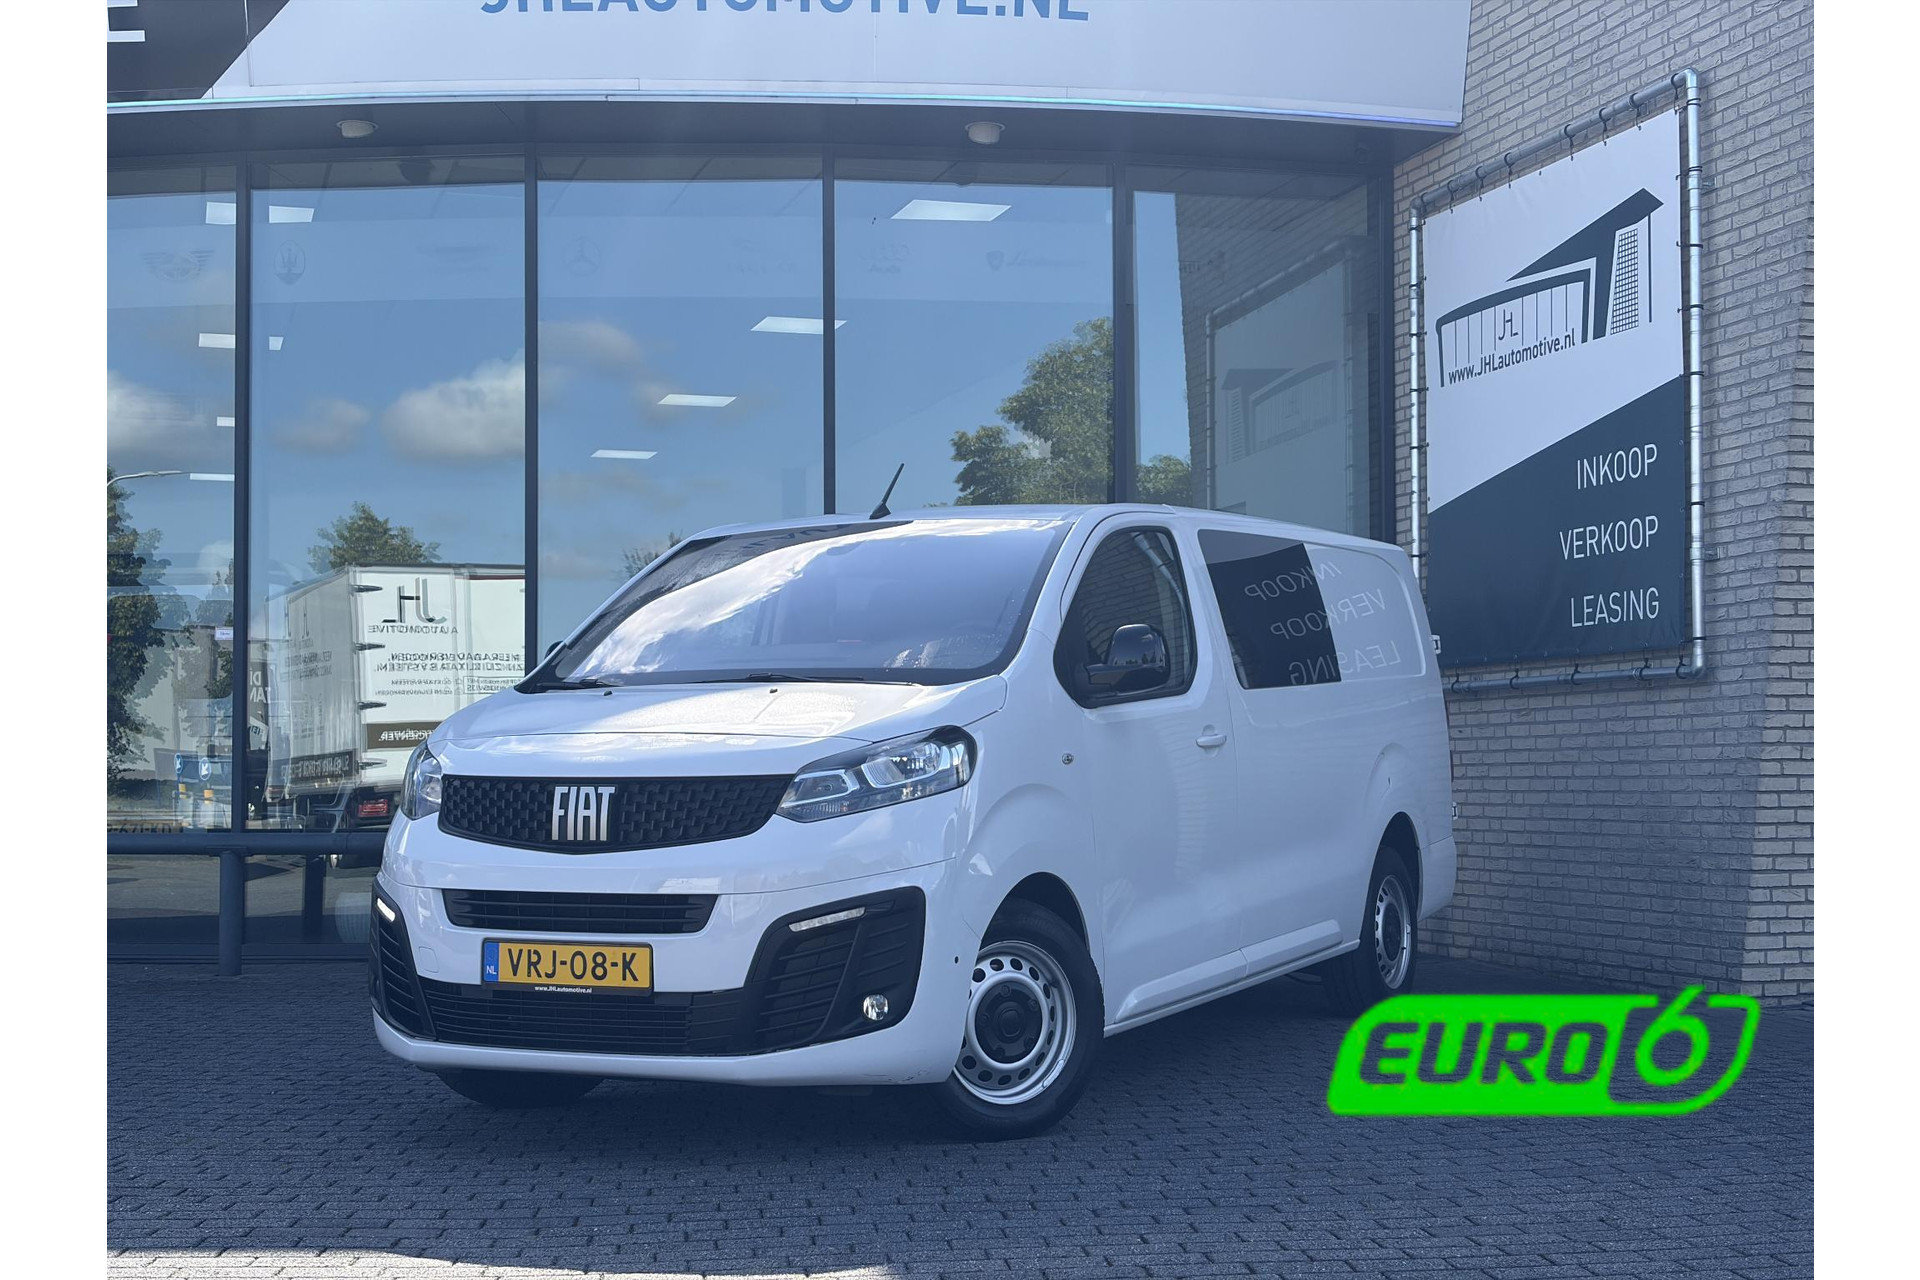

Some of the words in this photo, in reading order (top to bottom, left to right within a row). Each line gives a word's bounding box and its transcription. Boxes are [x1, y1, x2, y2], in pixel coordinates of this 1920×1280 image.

[1448, 327, 1576, 385] www.JHLautomotive.nl
[1577, 443, 1658, 490] INKOOP
[1559, 515, 1659, 560] VERKOOP
[1571, 587, 1659, 627] LEASING
[551, 786, 616, 841] FIAT
[486, 965, 497, 975] NL
[507, 947, 639, 982] VRJ-08-K
[535, 985, 592, 994] www.JHLautomotive.nl
